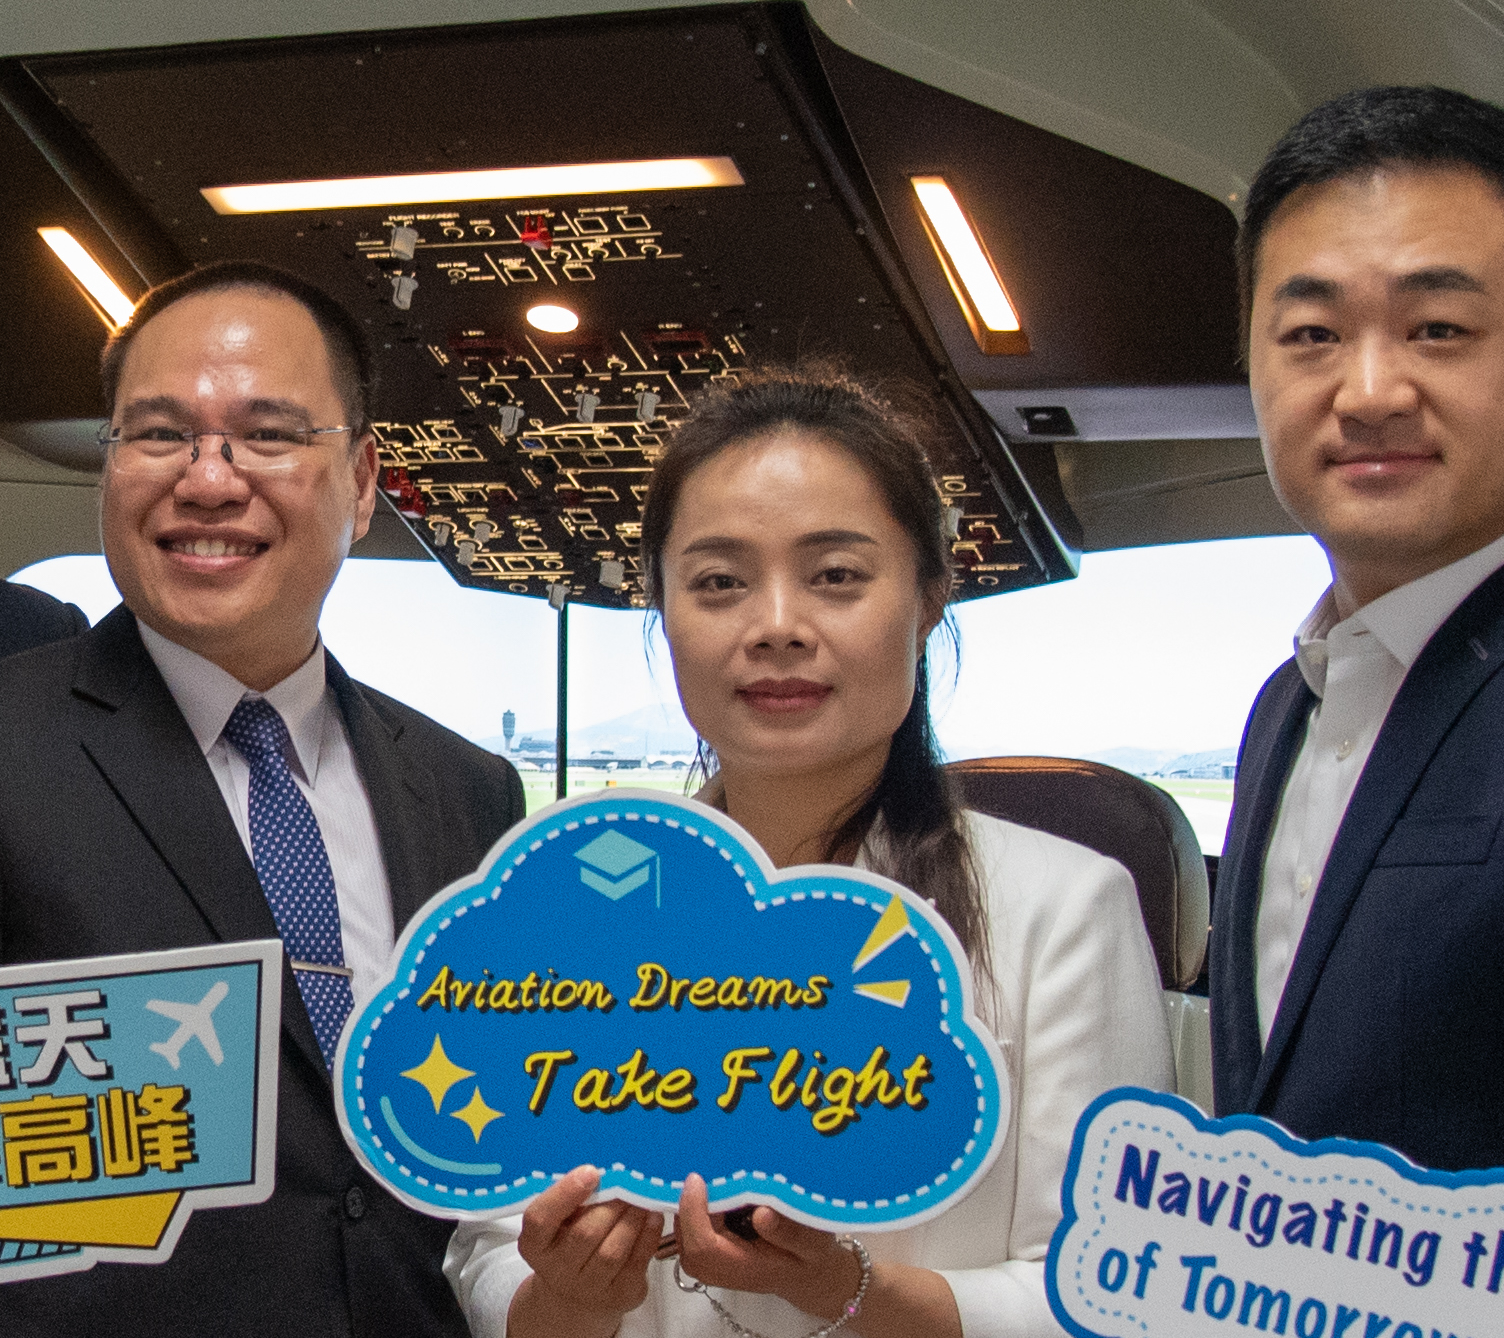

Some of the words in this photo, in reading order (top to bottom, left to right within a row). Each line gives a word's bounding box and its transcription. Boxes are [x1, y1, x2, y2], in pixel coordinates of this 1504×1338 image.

[417, 964, 615, 1013] Aviation
[628, 962, 835, 1012] Dreams
[523, 1048, 696, 1113] Take
[715, 1044, 933, 1135] Flight
[1114, 1143, 1443, 1287] Navigating
[1096, 1241, 1163, 1300] of
